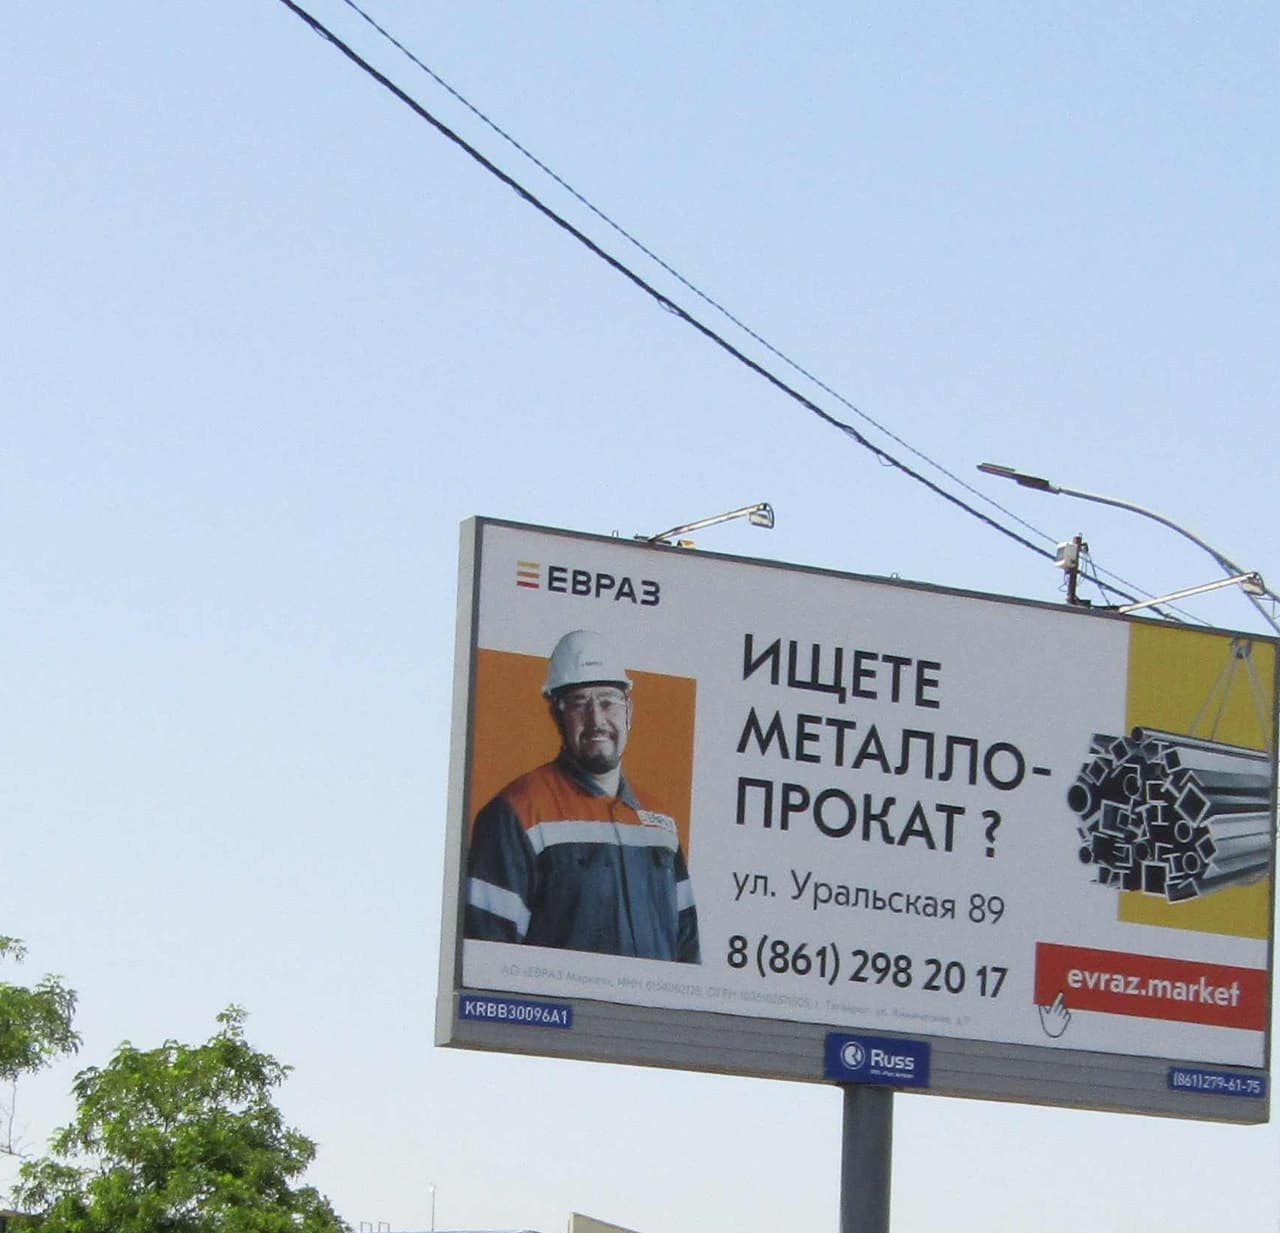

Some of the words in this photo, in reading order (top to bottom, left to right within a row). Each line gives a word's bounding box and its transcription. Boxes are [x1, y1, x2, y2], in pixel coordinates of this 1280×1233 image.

[548, 565, 660, 606] ЕВРАЗ
[742, 633, 941, 709] ИЩЕТЕ
[736, 706, 1051, 791] МЕТАЛЛО-
[736, 776, 965, 852] ПРОКАТ
[981, 809, 1002, 858] ?
[732, 871, 776, 901] ул.
[790, 869, 955, 919] Уральская
[968, 893, 1005, 924] 89
[727, 935, 748, 969] 8
[757, 934, 840, 986] (861)
[848, 949, 913, 988] 298
[922, 958, 965, 994] 20
[976, 965, 1008, 998] 17
[1067, 968, 1241, 1007] evraz.market
[465, 1001, 568, 1025] KRBB30096A1
[870, 1049, 915, 1070] Russ
